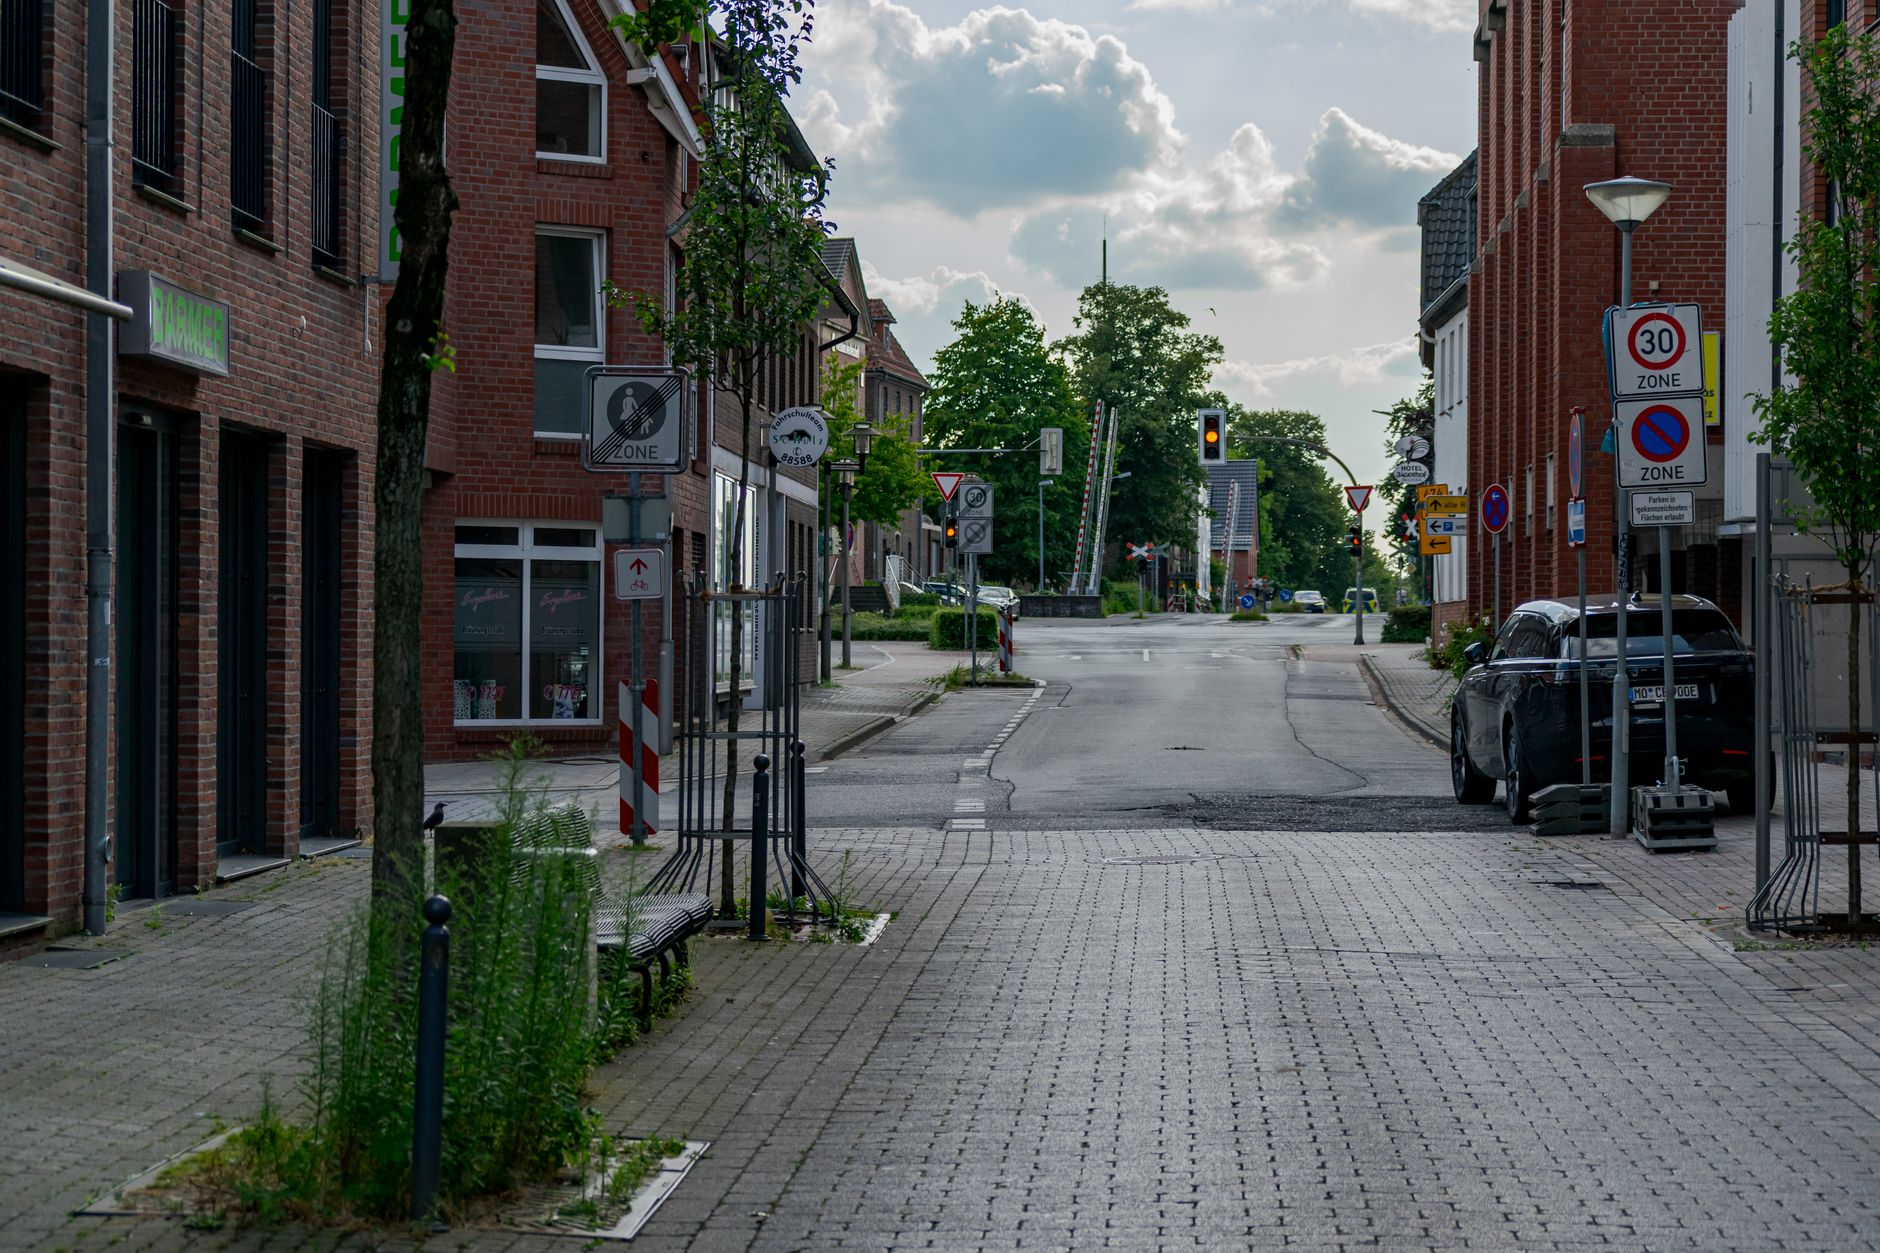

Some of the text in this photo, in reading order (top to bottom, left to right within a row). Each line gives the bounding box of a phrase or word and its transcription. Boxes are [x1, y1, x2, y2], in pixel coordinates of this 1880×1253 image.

[152, 286, 224, 363] BARMER
[1639, 328, 1673, 355] 30
[1637, 373, 1681, 390] ZONE
[771, 409, 824, 432] Fahrschulteam
[613, 444, 658, 460] ZONE
[781, 453, 813, 466] 88588
[1640, 465, 1685, 481] ZONE
[969, 492, 982, 503] 30
[1636, 504, 1688, 514] gekennzeichneten
[1640, 513, 1684, 521] Flächen erlaubt
[1634, 688, 1648, 699] MO
